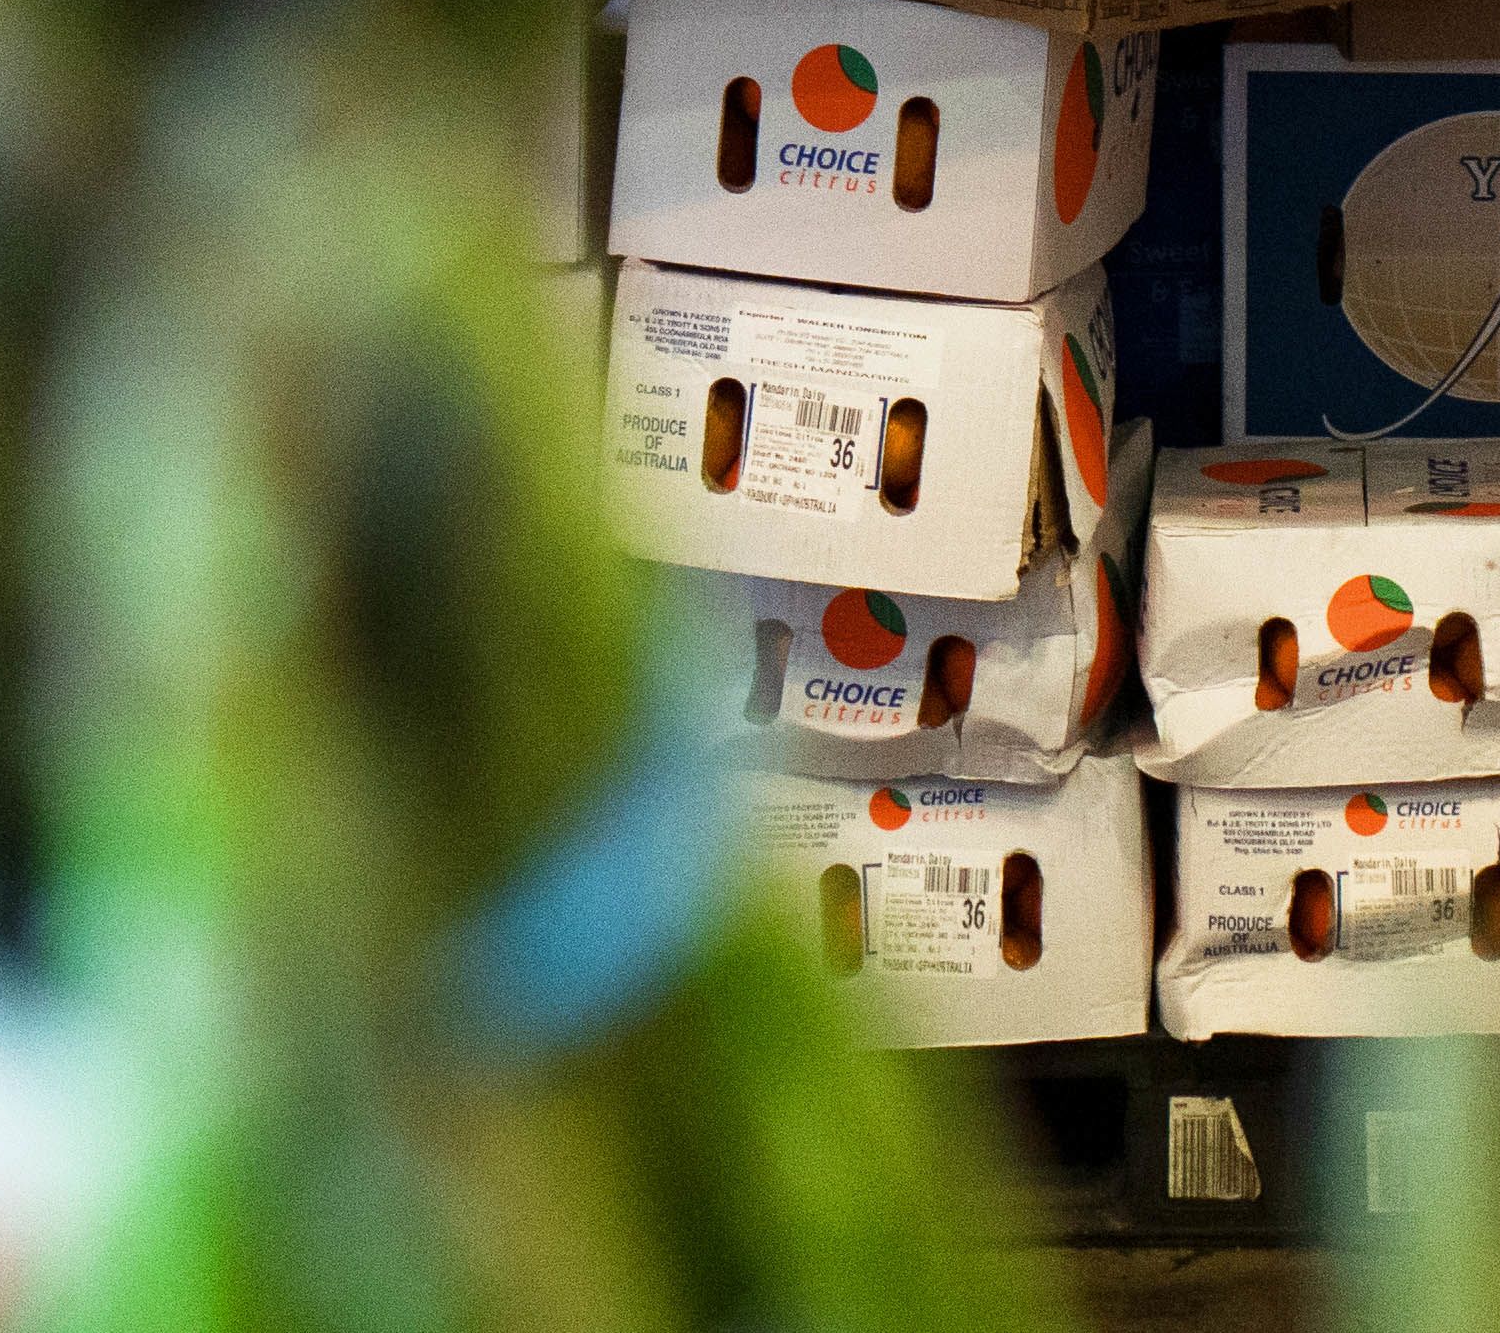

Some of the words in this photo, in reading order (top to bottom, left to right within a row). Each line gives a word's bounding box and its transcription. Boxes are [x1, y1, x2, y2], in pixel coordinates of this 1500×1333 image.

[779, 143, 881, 174] CHOICE
[779, 168, 878, 194] citrus
[635, 383, 673, 398] CLASS
[675, 387, 681, 399] 1
[622, 414, 688, 437] PRODUCE
[644, 434, 663, 451] OF
[830, 437, 856, 470] 36
[616, 450, 689, 473] AUSTRALIA
[1318, 654, 1417, 687] CHOICE
[804, 678, 907, 708] CHOICE
[1318, 676, 1413, 704] citrus
[804, 702, 901, 725] citrus
[920, 787, 986, 807] CHOICE
[921, 809, 986, 823] citrus
[1396, 801, 1462, 817] CHOICE
[1398, 817, 1462, 830] citrus
[1218, 884, 1257, 897] CLASS
[1259, 885, 1265, 897] 1
[961, 898, 986, 931] 36
[1431, 897, 1454, 923] 36
[1207, 915, 1274, 932] PRODUCE
[1203, 940, 1279, 958] AUSTRALIA
[1231, 932, 1248, 945] OF
